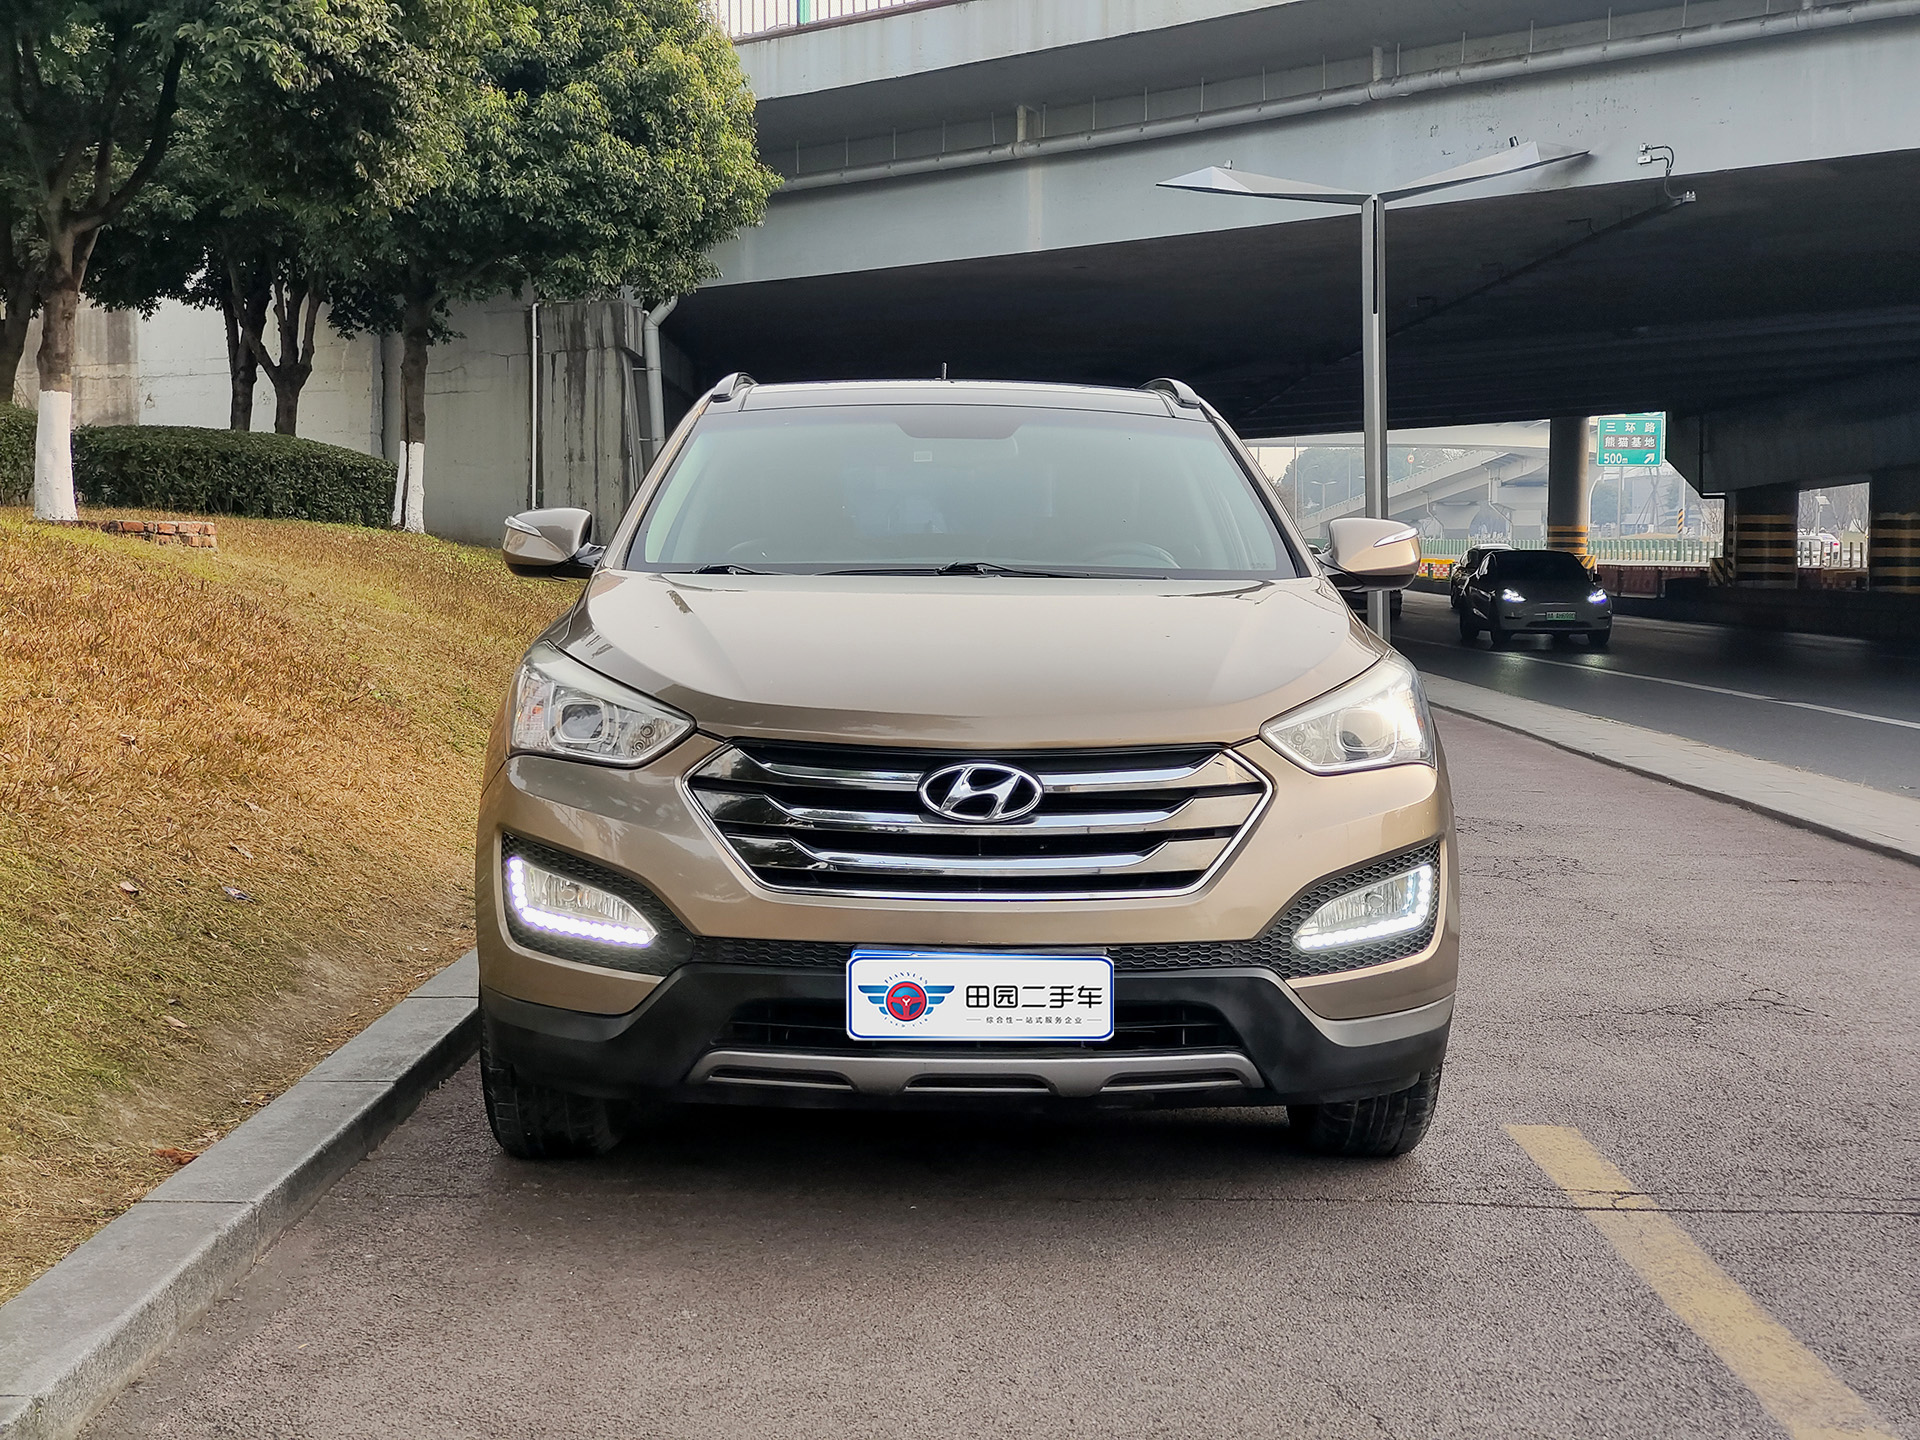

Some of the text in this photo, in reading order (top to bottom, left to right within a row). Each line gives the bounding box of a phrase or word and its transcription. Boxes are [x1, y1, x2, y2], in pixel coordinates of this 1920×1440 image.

[1605, 422, 1656, 433] 三环路
[1604, 436, 1656, 448] 熊猫基地
[1603, 453, 1628, 464] 500m
